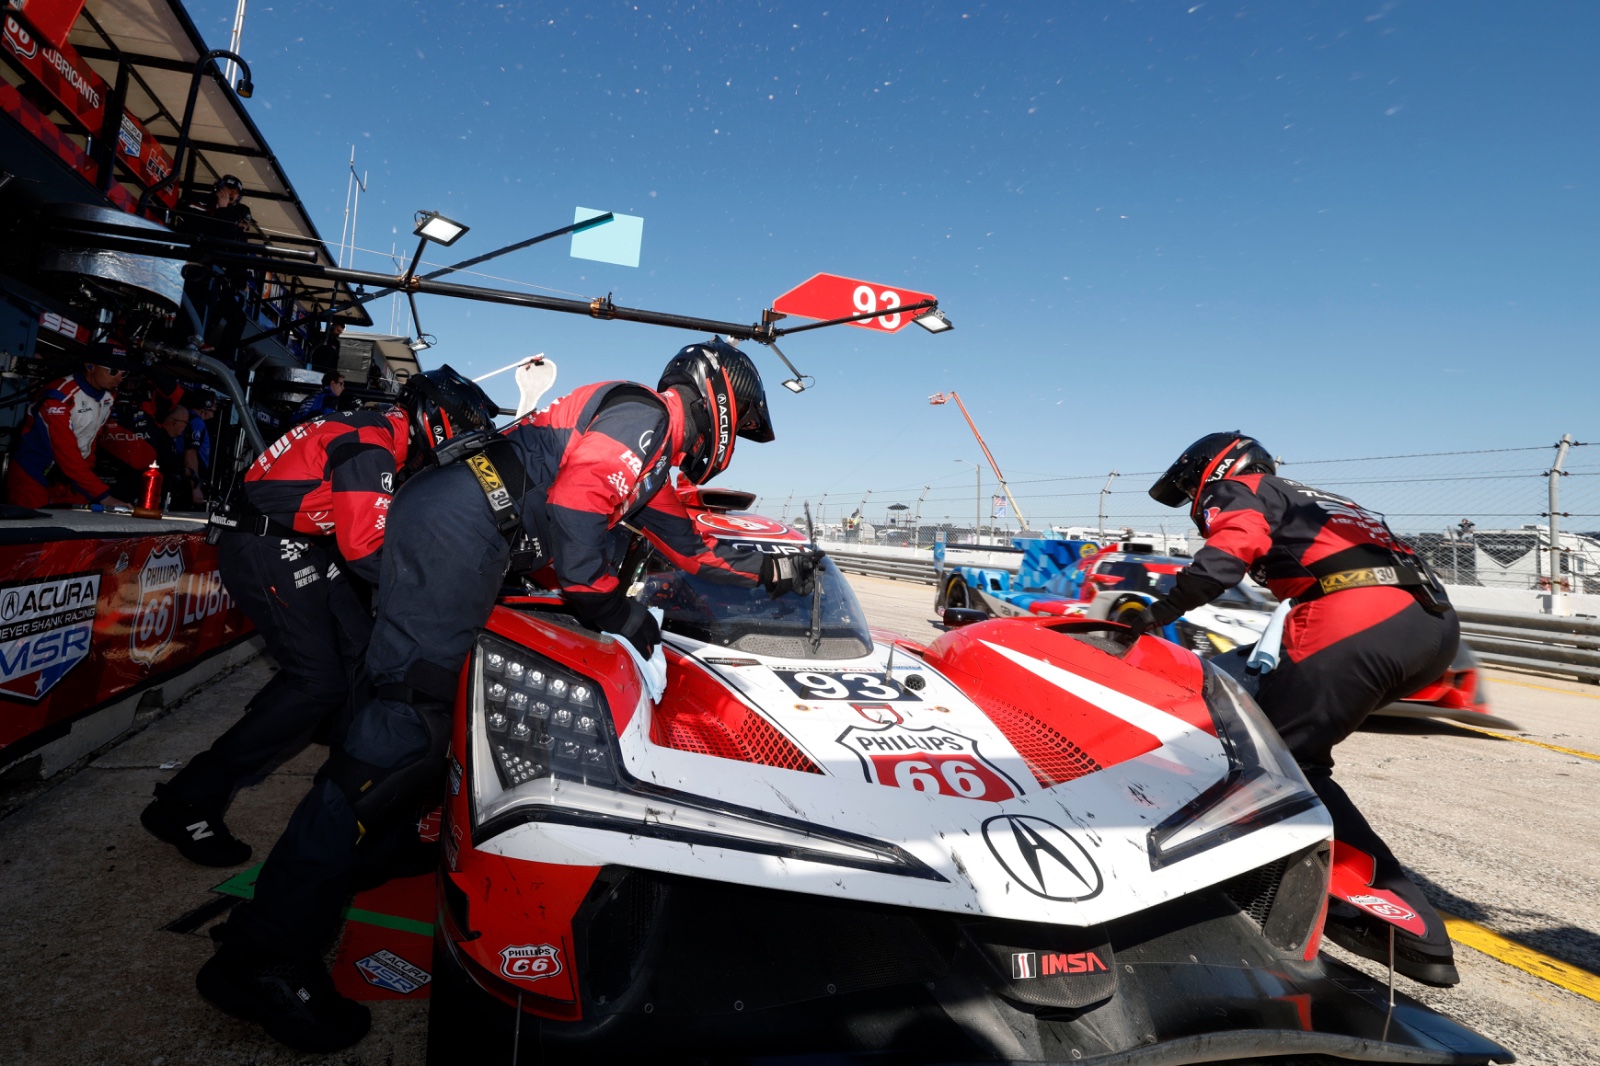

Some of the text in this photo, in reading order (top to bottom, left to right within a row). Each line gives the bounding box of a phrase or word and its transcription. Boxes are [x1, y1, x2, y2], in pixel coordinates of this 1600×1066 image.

[42, 48, 100, 109] LUBRICANTS
[853, 285, 901, 329] 93
[43, 312, 78, 339] 93
[105, 432, 151, 441] ACURA
[718, 405, 728, 454] ACURA
[491, 491, 511, 507] 30
[145, 564, 178, 588] PHILLIPS
[1377, 567, 1394, 582] 30
[19, 580, 95, 616] ACURA
[31, 617, 63, 632] SHANK
[64, 607, 97, 624] RACING
[140, 595, 172, 641] 66
[0, 626, 90, 677] MSR
[794, 672, 900, 700] 93
[855, 735, 964, 751] PHILLIPS
[894, 760, 987, 798] 66
[508, 948, 551, 957] PHILLIPS
[512, 958, 550, 973] 66
[1041, 952, 1109, 976] IMSA
[359, 959, 415, 991] MSR
[386, 957, 428, 982] ACURA
